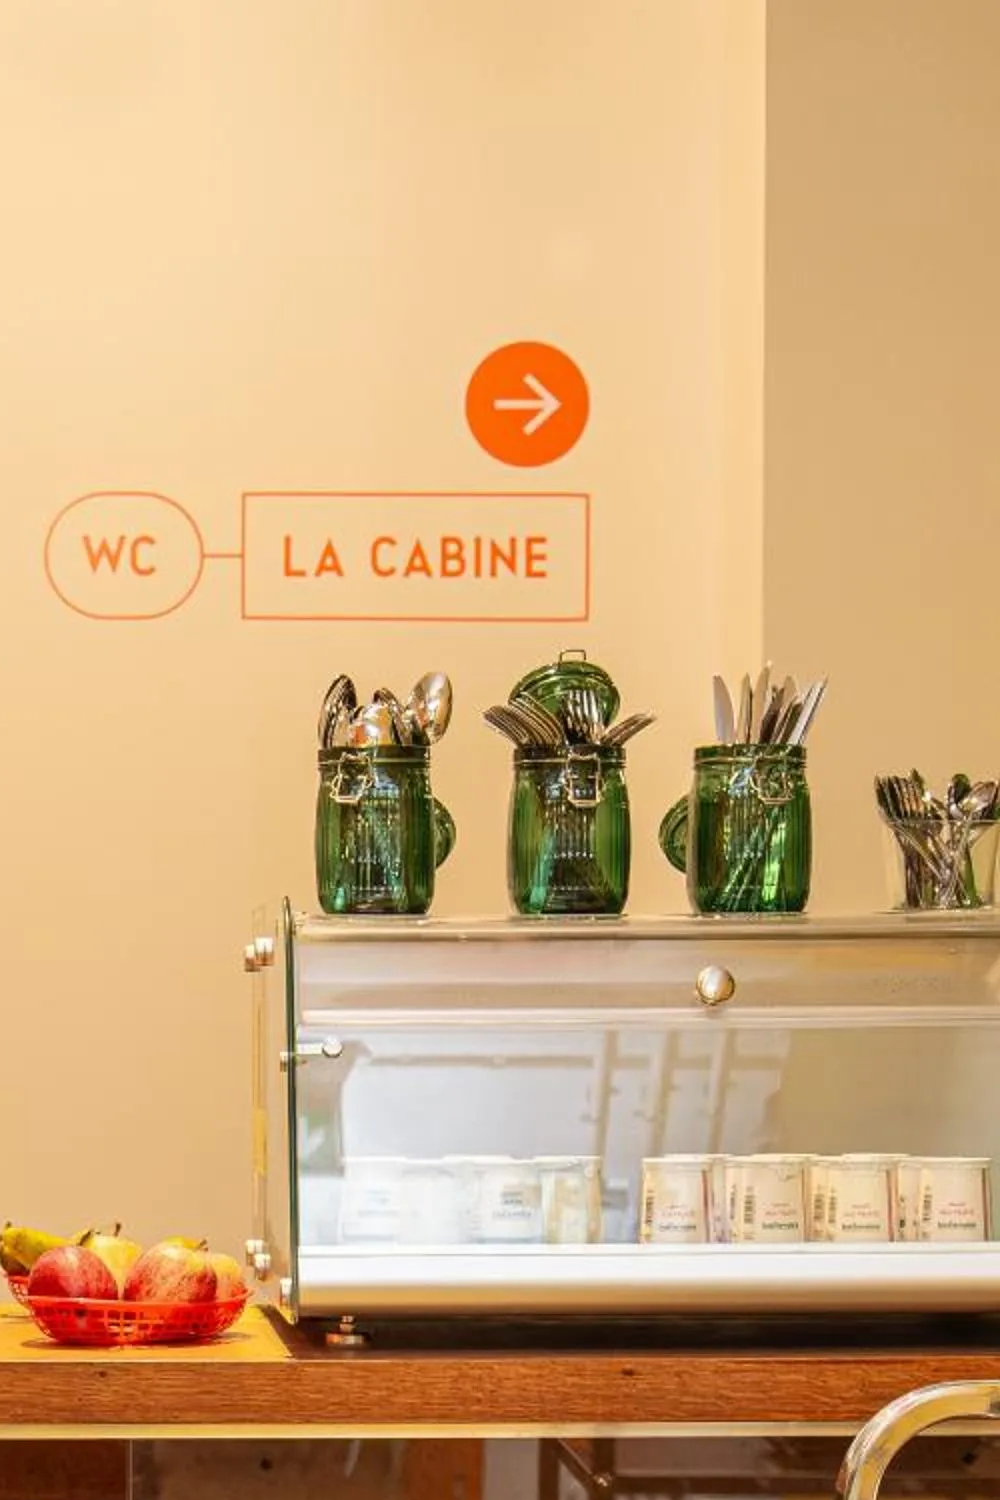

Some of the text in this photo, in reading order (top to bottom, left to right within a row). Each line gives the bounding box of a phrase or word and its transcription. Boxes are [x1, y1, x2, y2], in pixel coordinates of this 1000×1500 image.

[82, 535, 157, 577] WC
[283, 535, 549, 579] LA CABINE
